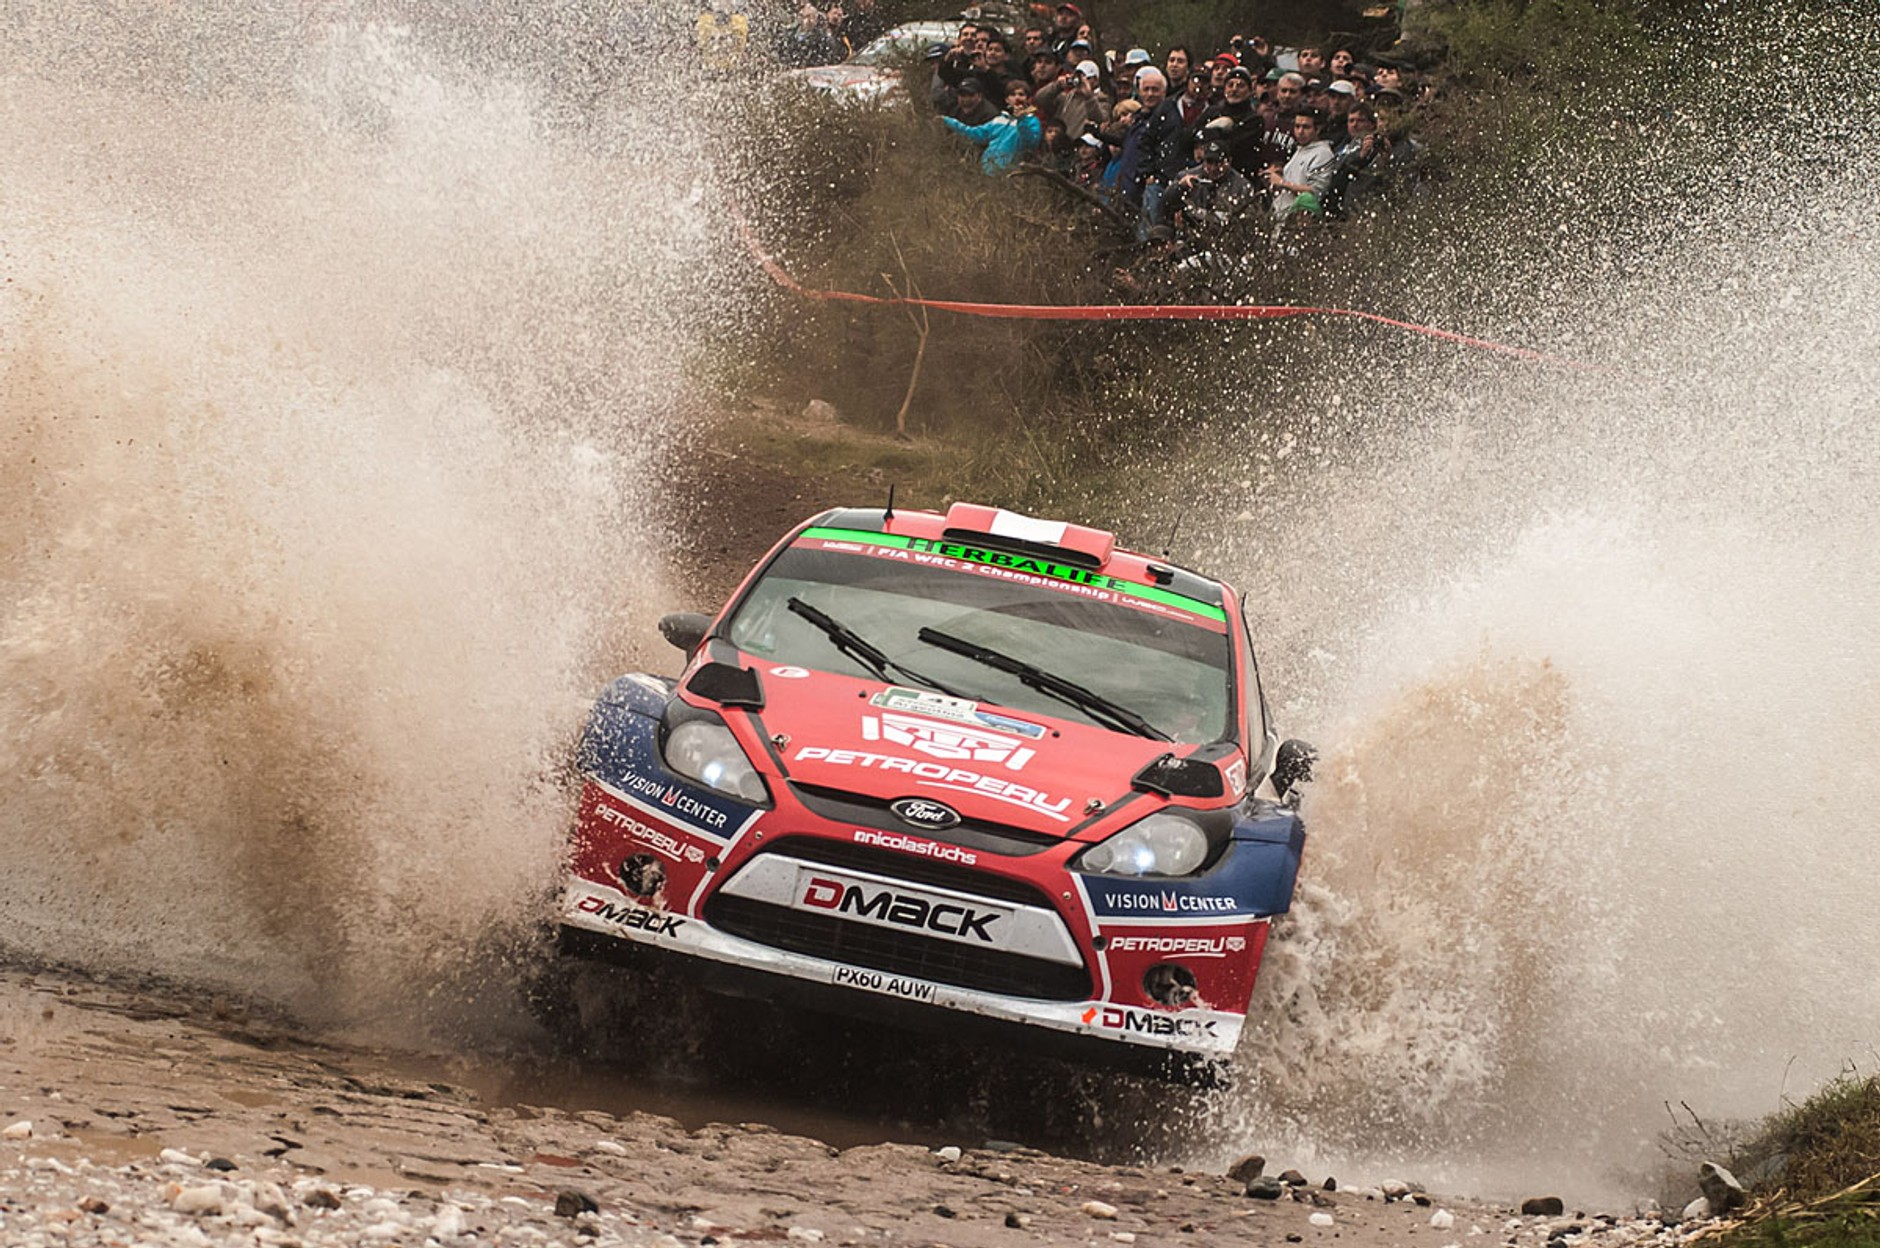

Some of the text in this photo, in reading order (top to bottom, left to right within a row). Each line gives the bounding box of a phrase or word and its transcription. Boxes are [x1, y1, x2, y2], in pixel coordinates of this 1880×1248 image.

[878, 548, 1109, 600] FIA WRC 2 Championship
[907, 537, 1127, 592] HERBALIFE
[622, 771, 665, 798] VISION
[676, 796, 728, 828] CENTER
[795, 747, 1073, 813] PETROPERU
[594, 804, 687, 856] PETROPERU
[904, 802, 947, 822] Ford
[1105, 893, 1160, 909] VISION
[1179, 896, 1237, 910] CENTER
[1110, 936, 1225, 952] PETROPERU
[836, 967, 932, 999] PX60 AUW
